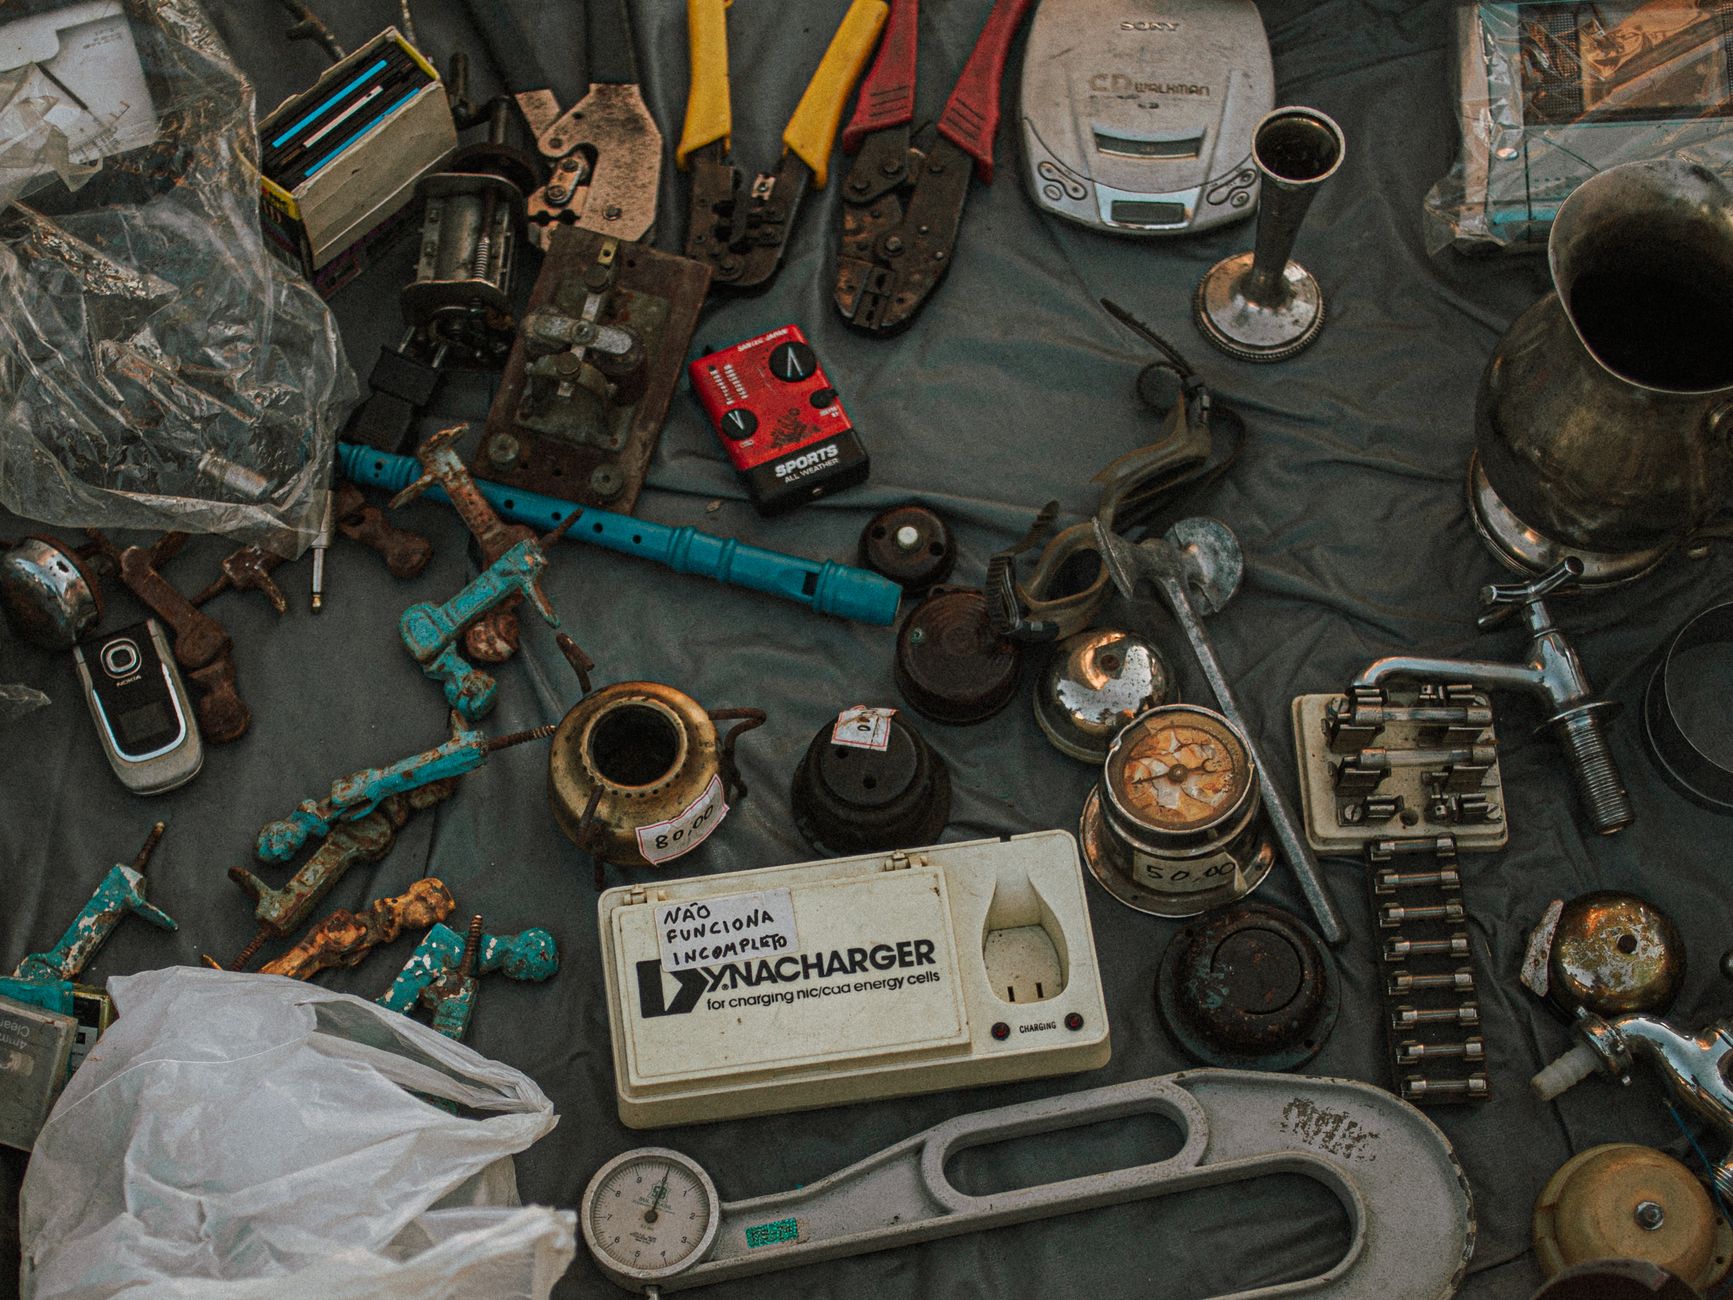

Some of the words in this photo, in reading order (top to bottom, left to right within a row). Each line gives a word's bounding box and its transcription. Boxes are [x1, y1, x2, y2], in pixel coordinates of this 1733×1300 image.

[1120, 21, 1180, 32] SONY
[775, 444, 839, 478] SPORTS
[785, 473, 800, 484] ALL
[800, 457, 839, 477] WEATHER
[655, 804, 714, 850] 80,00
[1146, 862, 1236, 883] 50,00
[663, 902, 711, 925] NÃO
[666, 908, 775, 944] FUNCIONA
[673, 933, 788, 966] INCOMPLETO
[707, 998, 726, 1010] for
[853, 976, 905, 991] energy
[906, 970, 941, 985] cells
[1019, 1021, 1057, 1034] CHARGING
